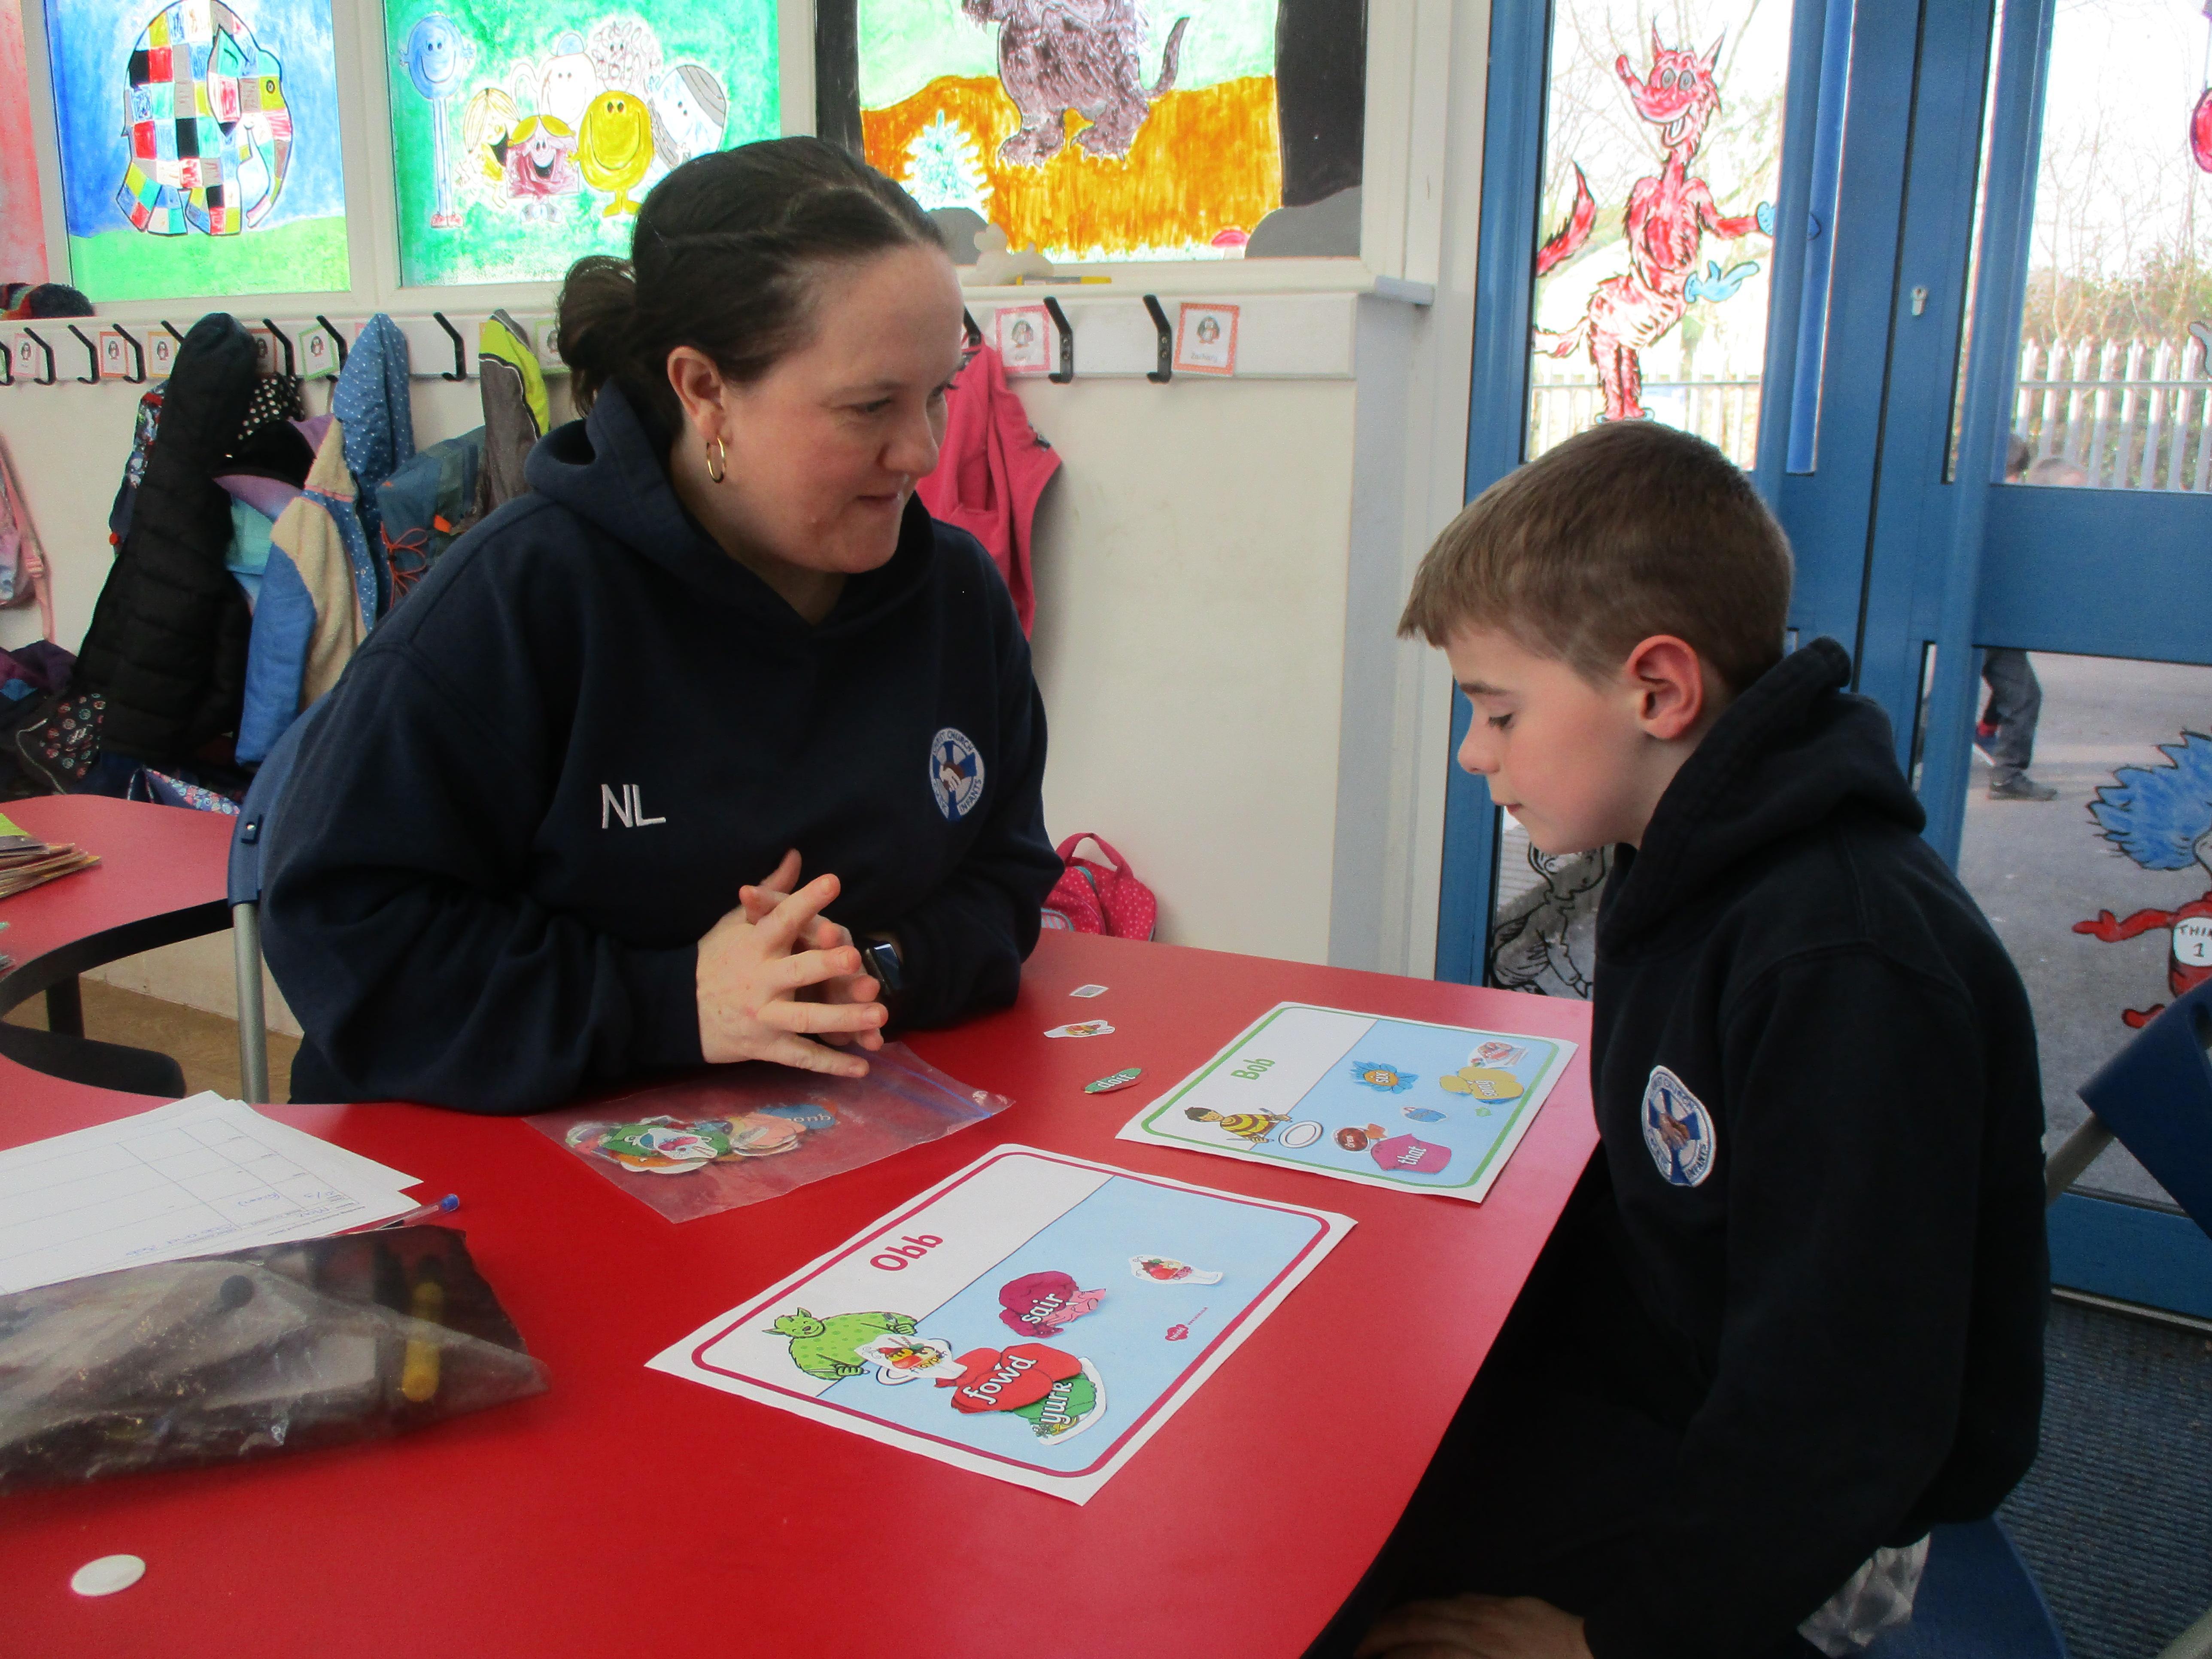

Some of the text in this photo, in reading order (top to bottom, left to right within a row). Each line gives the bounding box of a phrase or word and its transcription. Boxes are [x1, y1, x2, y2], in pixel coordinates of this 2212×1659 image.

[948, 730, 974, 752] CHURCH
[601, 783, 666, 829] NL
[958, 778, 982, 812] INFANTS
[2193, 943, 2205, 957] 1
[1231, 1057, 1275, 1080] Bob
[1375, 1072, 1389, 1083] six
[1097, 1072, 1136, 1089] doit
[1475, 1079, 1498, 1097] song
[1397, 1146, 1426, 1165] that
[869, 1233, 943, 1271] Obb
[1021, 1292, 1064, 1325] sair
[962, 1354, 1037, 1406] fowd
[1039, 1380, 1073, 1425] yurk
